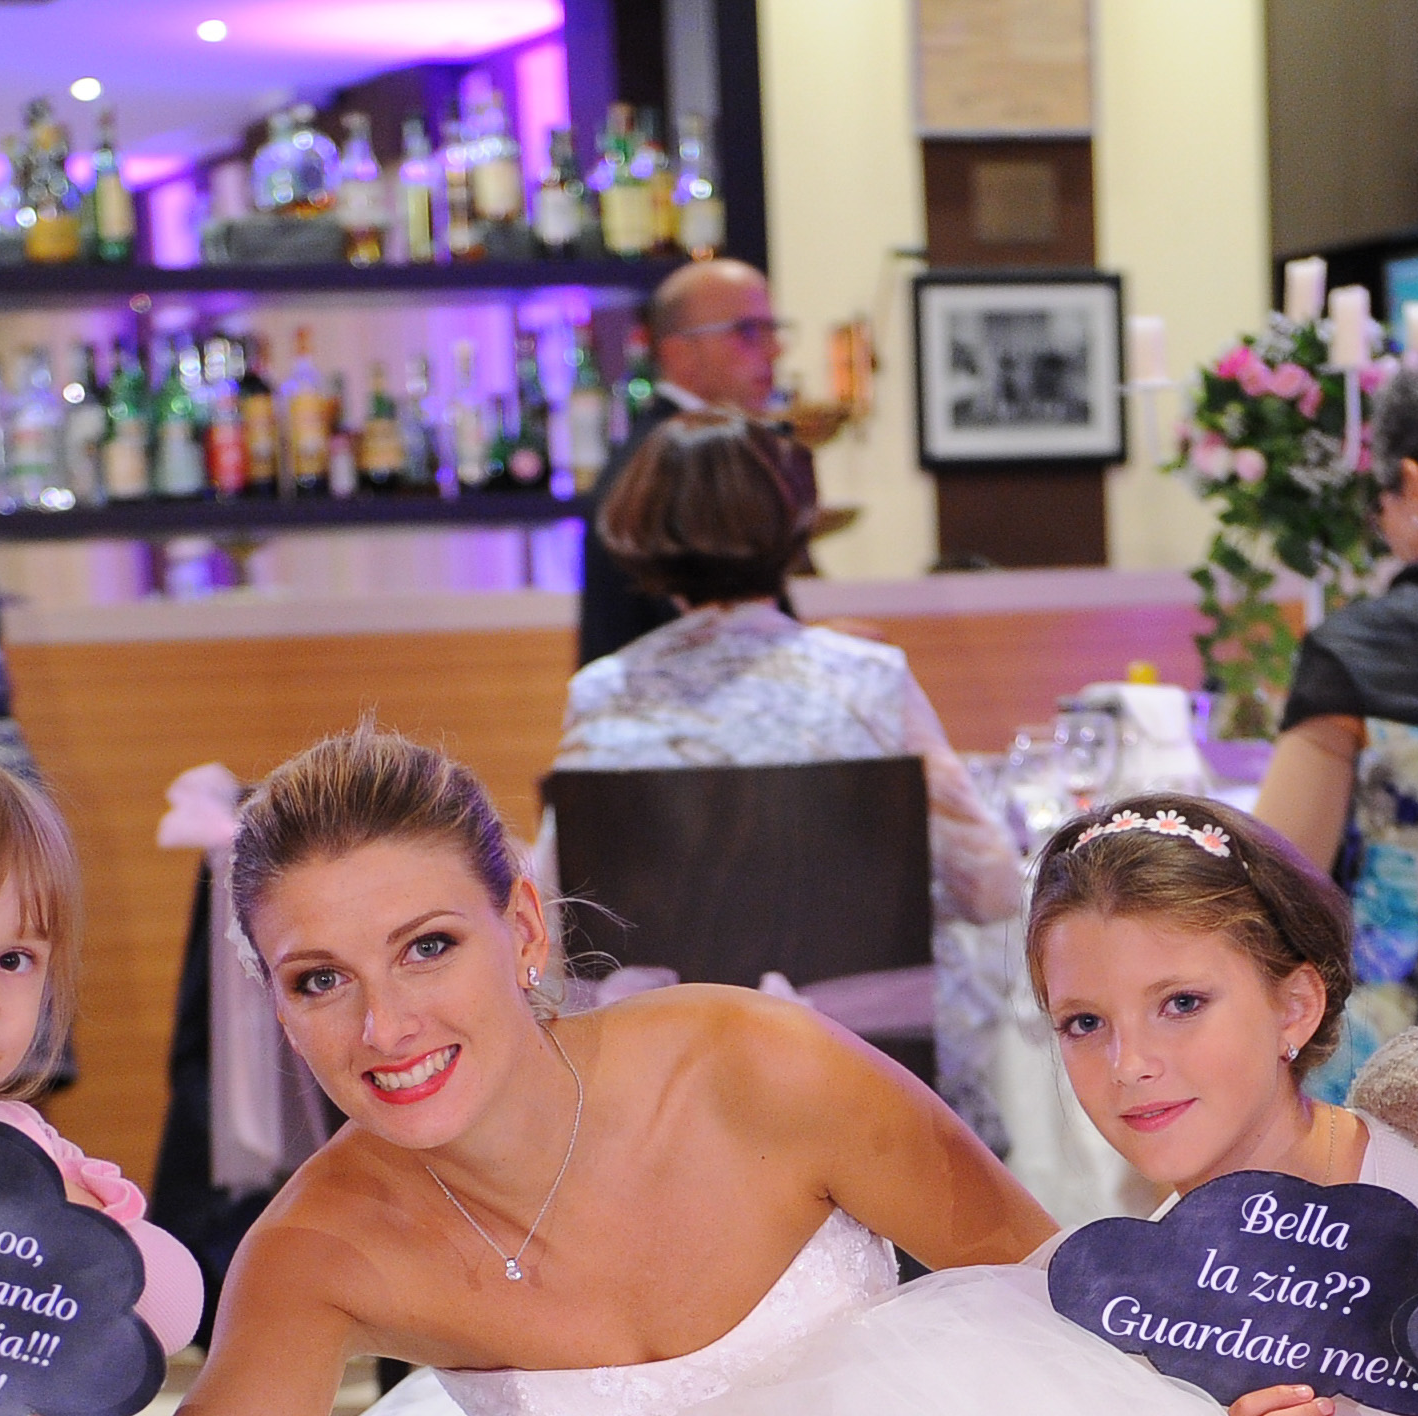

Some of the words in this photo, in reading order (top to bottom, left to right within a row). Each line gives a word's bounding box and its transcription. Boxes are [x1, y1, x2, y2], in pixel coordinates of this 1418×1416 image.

[1240, 1191, 1350, 1250] Bella
[1197, 1249, 1239, 1293] la
[1248, 1265, 1370, 1314] zia??
[1102, 1296, 1310, 1369] Guardate
